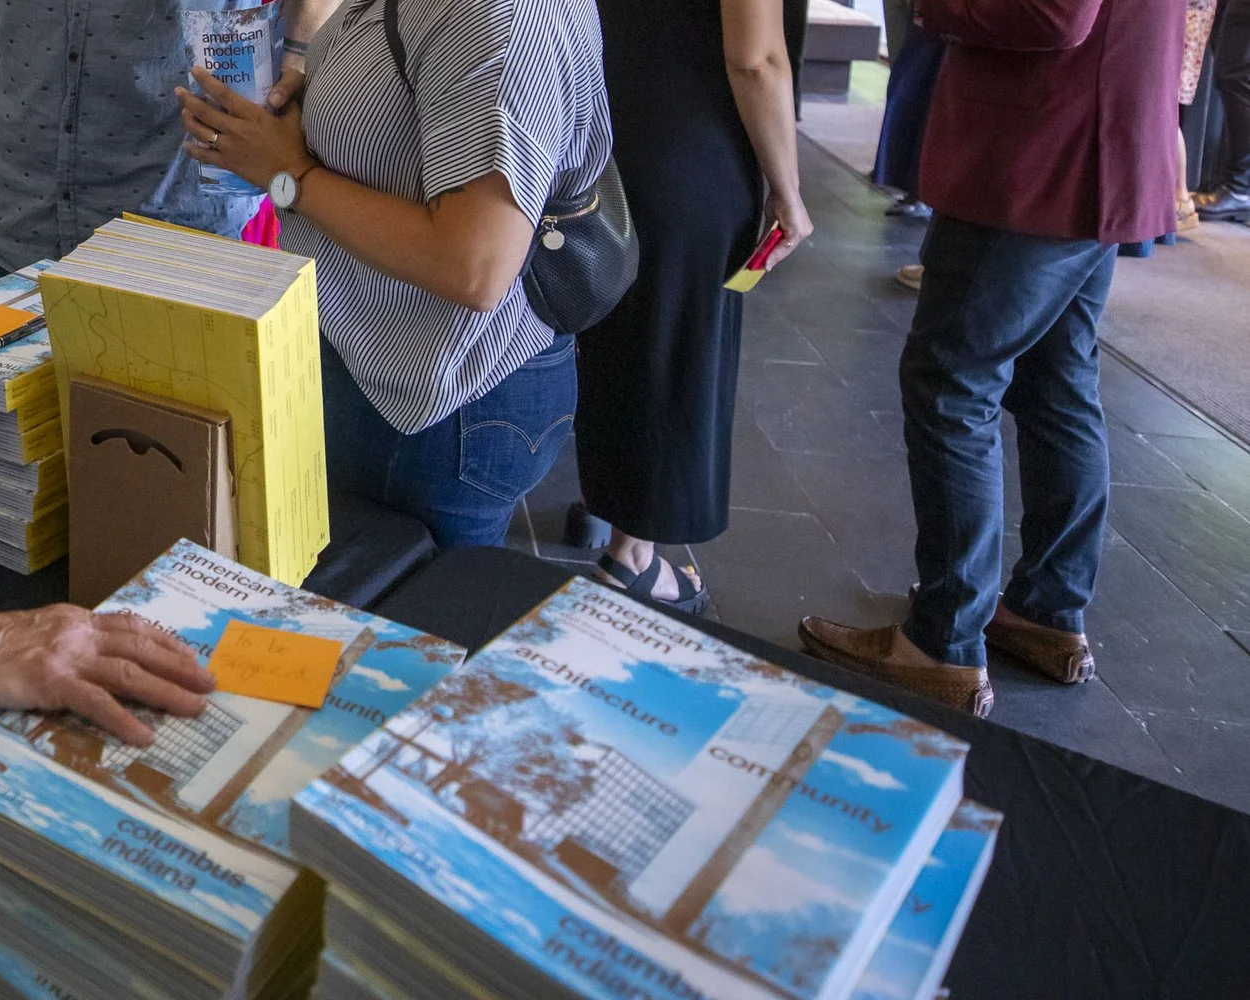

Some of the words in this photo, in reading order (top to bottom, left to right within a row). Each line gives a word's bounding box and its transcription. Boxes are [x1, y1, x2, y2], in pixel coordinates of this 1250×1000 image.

[202, 29, 263, 44] american
[203, 44, 256, 57] modern
[205, 58, 238, 70] book
[211, 70, 251, 83] unch
[171, 560, 250, 602] modern
[183, 550, 276, 598] american
[572, 602, 672, 655] modern
[582, 592, 703, 653] american
[514, 646, 679, 737] architecture
[101, 831, 197, 891] indiana
[116, 818, 246, 889] columbus
